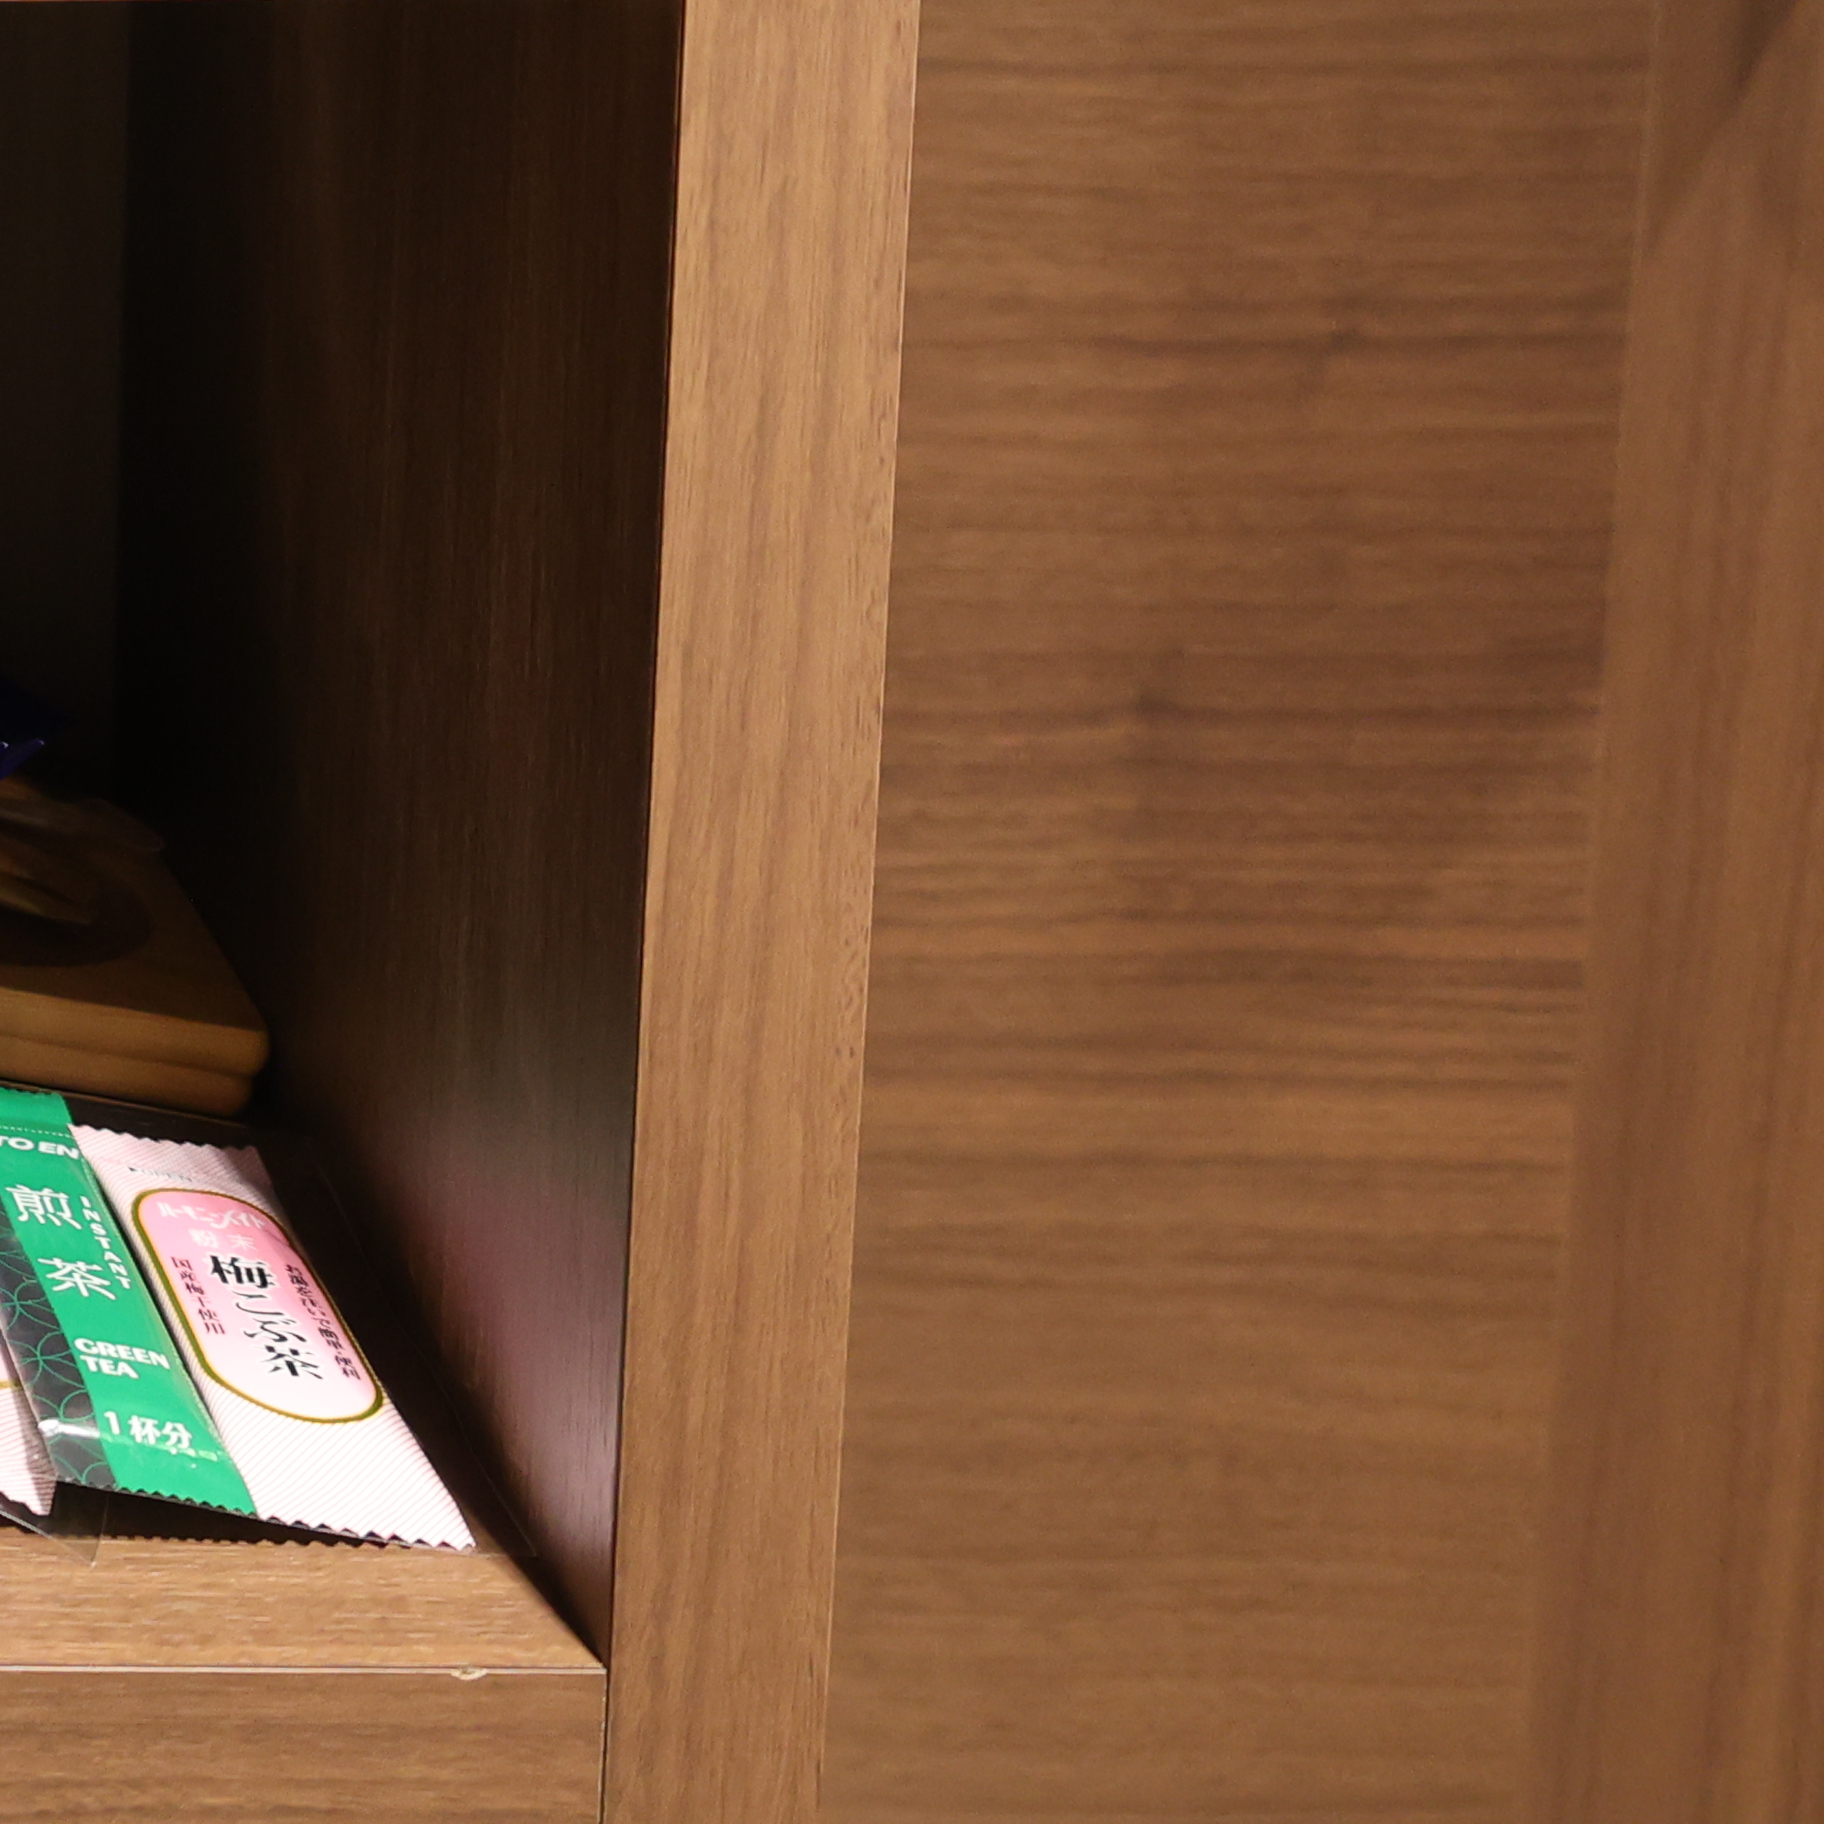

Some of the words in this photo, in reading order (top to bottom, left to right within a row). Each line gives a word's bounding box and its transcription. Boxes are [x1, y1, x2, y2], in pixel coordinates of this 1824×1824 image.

[38, 1141, 81, 1160] EN
[5, 1183, 116, 1302] 煎茶
[80, 1195, 131, 1290] INSTANT
[209, 1254, 325, 1381] 梅こぶ茶
[73, 1337, 171, 1370] GREEN
[79, 1354, 139, 1379] TEA
